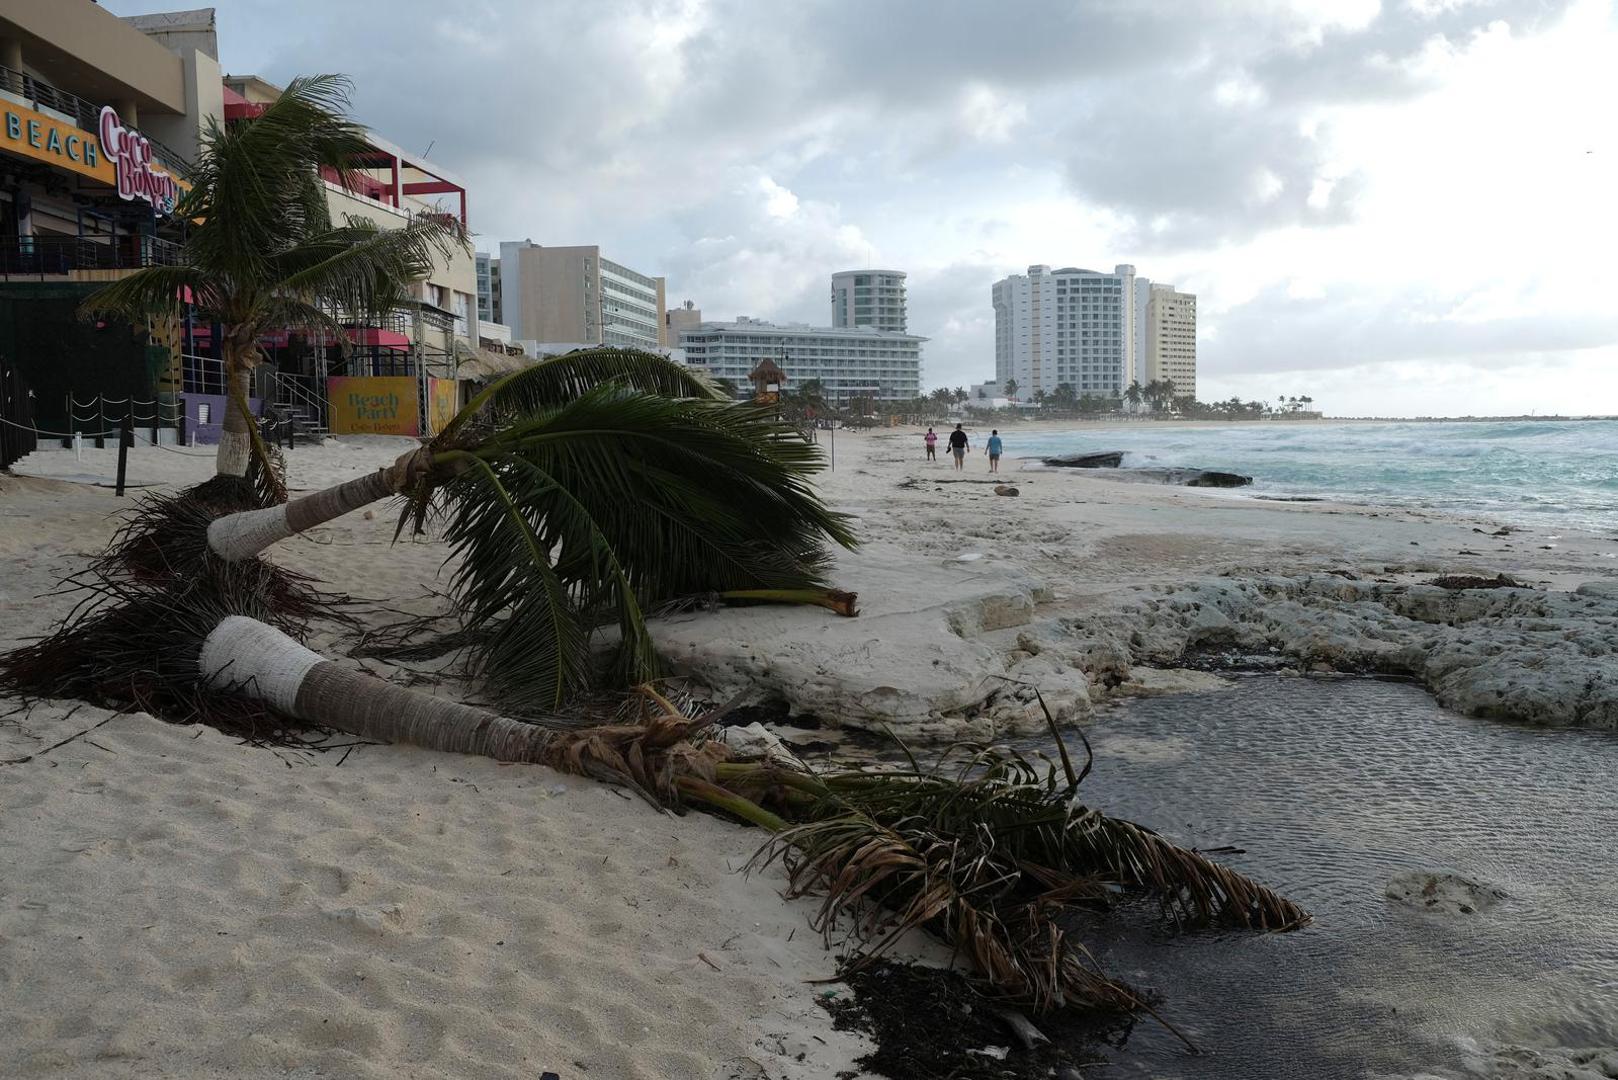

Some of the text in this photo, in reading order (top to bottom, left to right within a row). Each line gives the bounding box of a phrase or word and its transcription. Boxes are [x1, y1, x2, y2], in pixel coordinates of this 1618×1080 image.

[6, 111, 98, 168] BEACH
[100, 109, 152, 167] Coco
[348, 392, 398, 406] Beach
